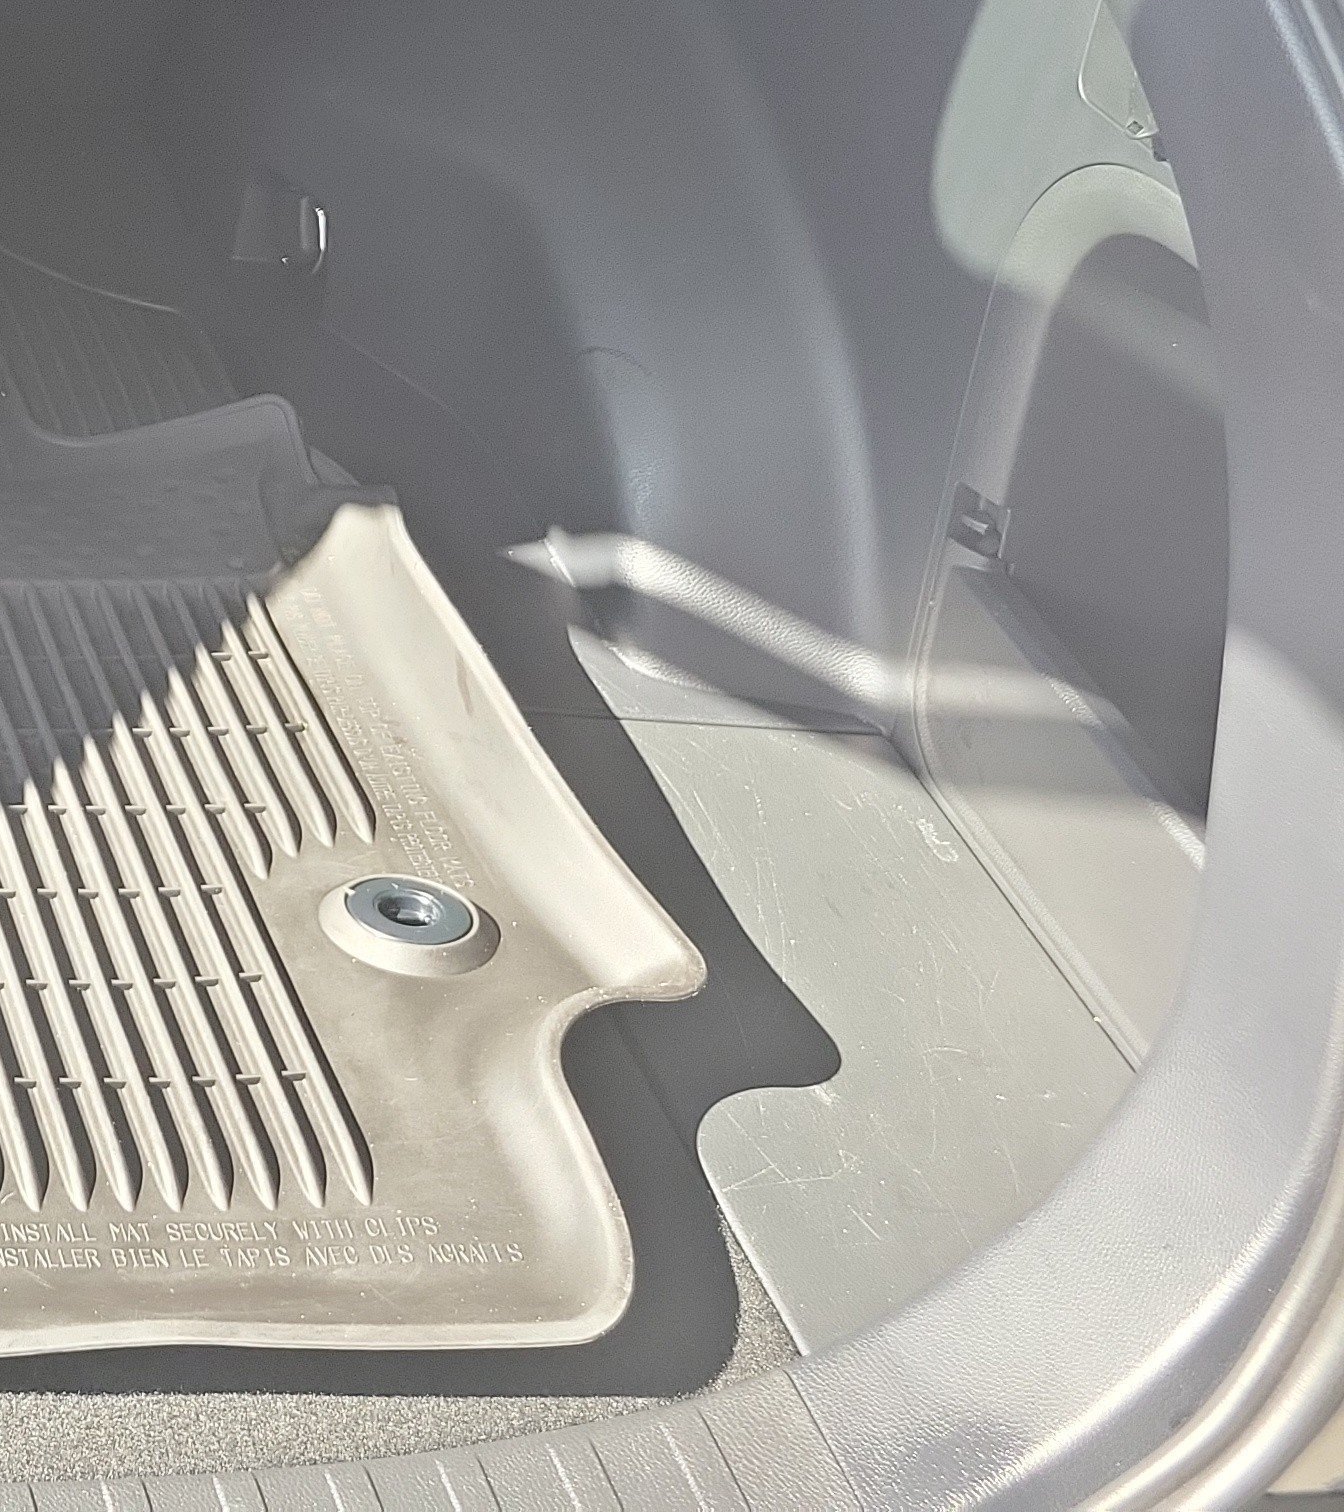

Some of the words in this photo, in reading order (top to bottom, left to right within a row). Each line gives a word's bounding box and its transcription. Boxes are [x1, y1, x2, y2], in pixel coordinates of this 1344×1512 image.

[413, 807, 453, 853] FLOOR
[109, 1222, 150, 1243] MAT
[165, 1221, 279, 1242] SECURELY
[291, 1218, 355, 1240] WITH
[364, 1216, 439, 1238] CLIPS
[111, 1246, 170, 1269] BIEN
[179, 1246, 210, 1269] LE
[219, 1244, 291, 1268] TAPIS
[304, 1243, 359, 1267] AVEC
